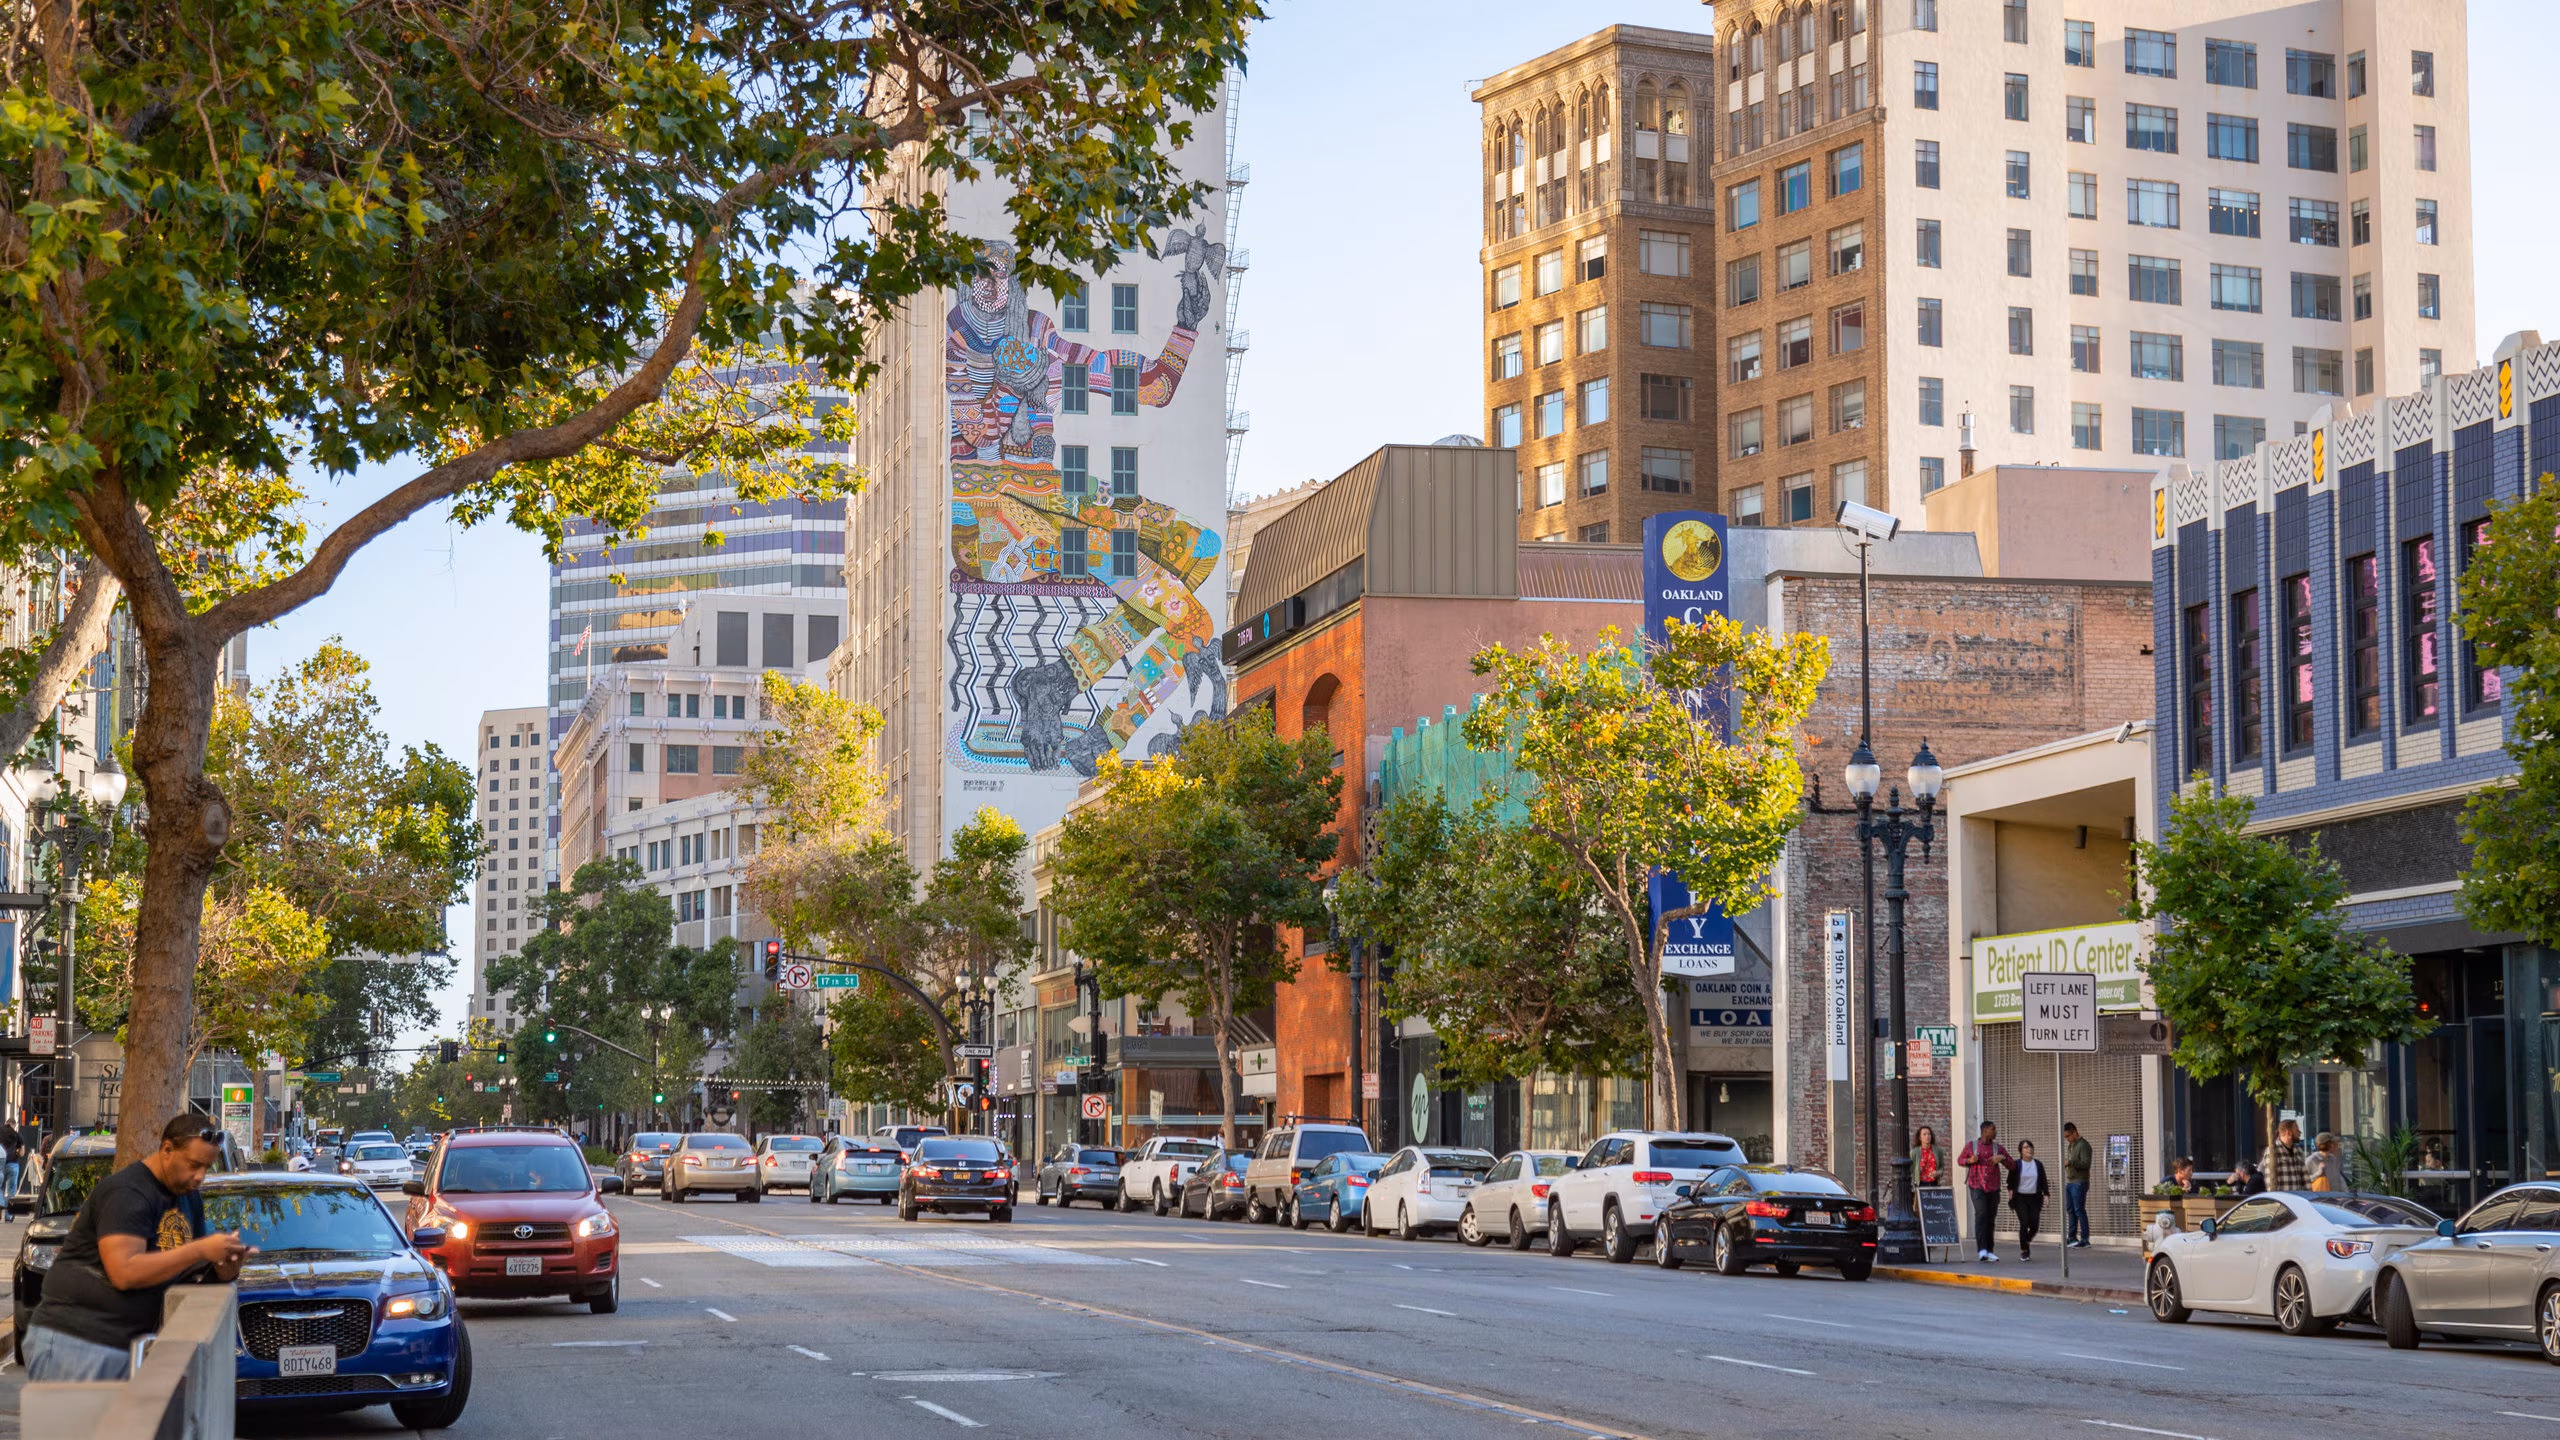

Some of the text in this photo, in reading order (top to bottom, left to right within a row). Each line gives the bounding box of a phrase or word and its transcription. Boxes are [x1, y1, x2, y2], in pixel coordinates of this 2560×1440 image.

[1662, 588, 1723, 601] OAKLAND
[1665, 943, 1732, 954] EXCHANGE
[1679, 959, 1718, 969] LOANS
[1834, 949, 1845, 974] 19th
[1987, 935, 2133, 985] Patient ID Center
[1695, 983, 1771, 993] OAKLAND COIN &
[2030, 983, 2088, 995] LEFT LANE
[1994, 992, 2010, 1007] 1733
[2040, 1005, 2079, 1019] MUST
[31, 1019, 42, 1028] NO
[1920, 1029, 1955, 1045] ATM
[2030, 1028, 2089, 1041] TURN LEFT
[1721, 1037, 1733, 1045] WE
[1734, 1037, 1749, 1045] BUY
[1909, 1042, 1920, 1050] NO
[2108, 1042, 2167, 1052] punchdown
[508, 1264, 539, 1273] 6XTE275
[283, 1357, 332, 1371] 8DIY468
